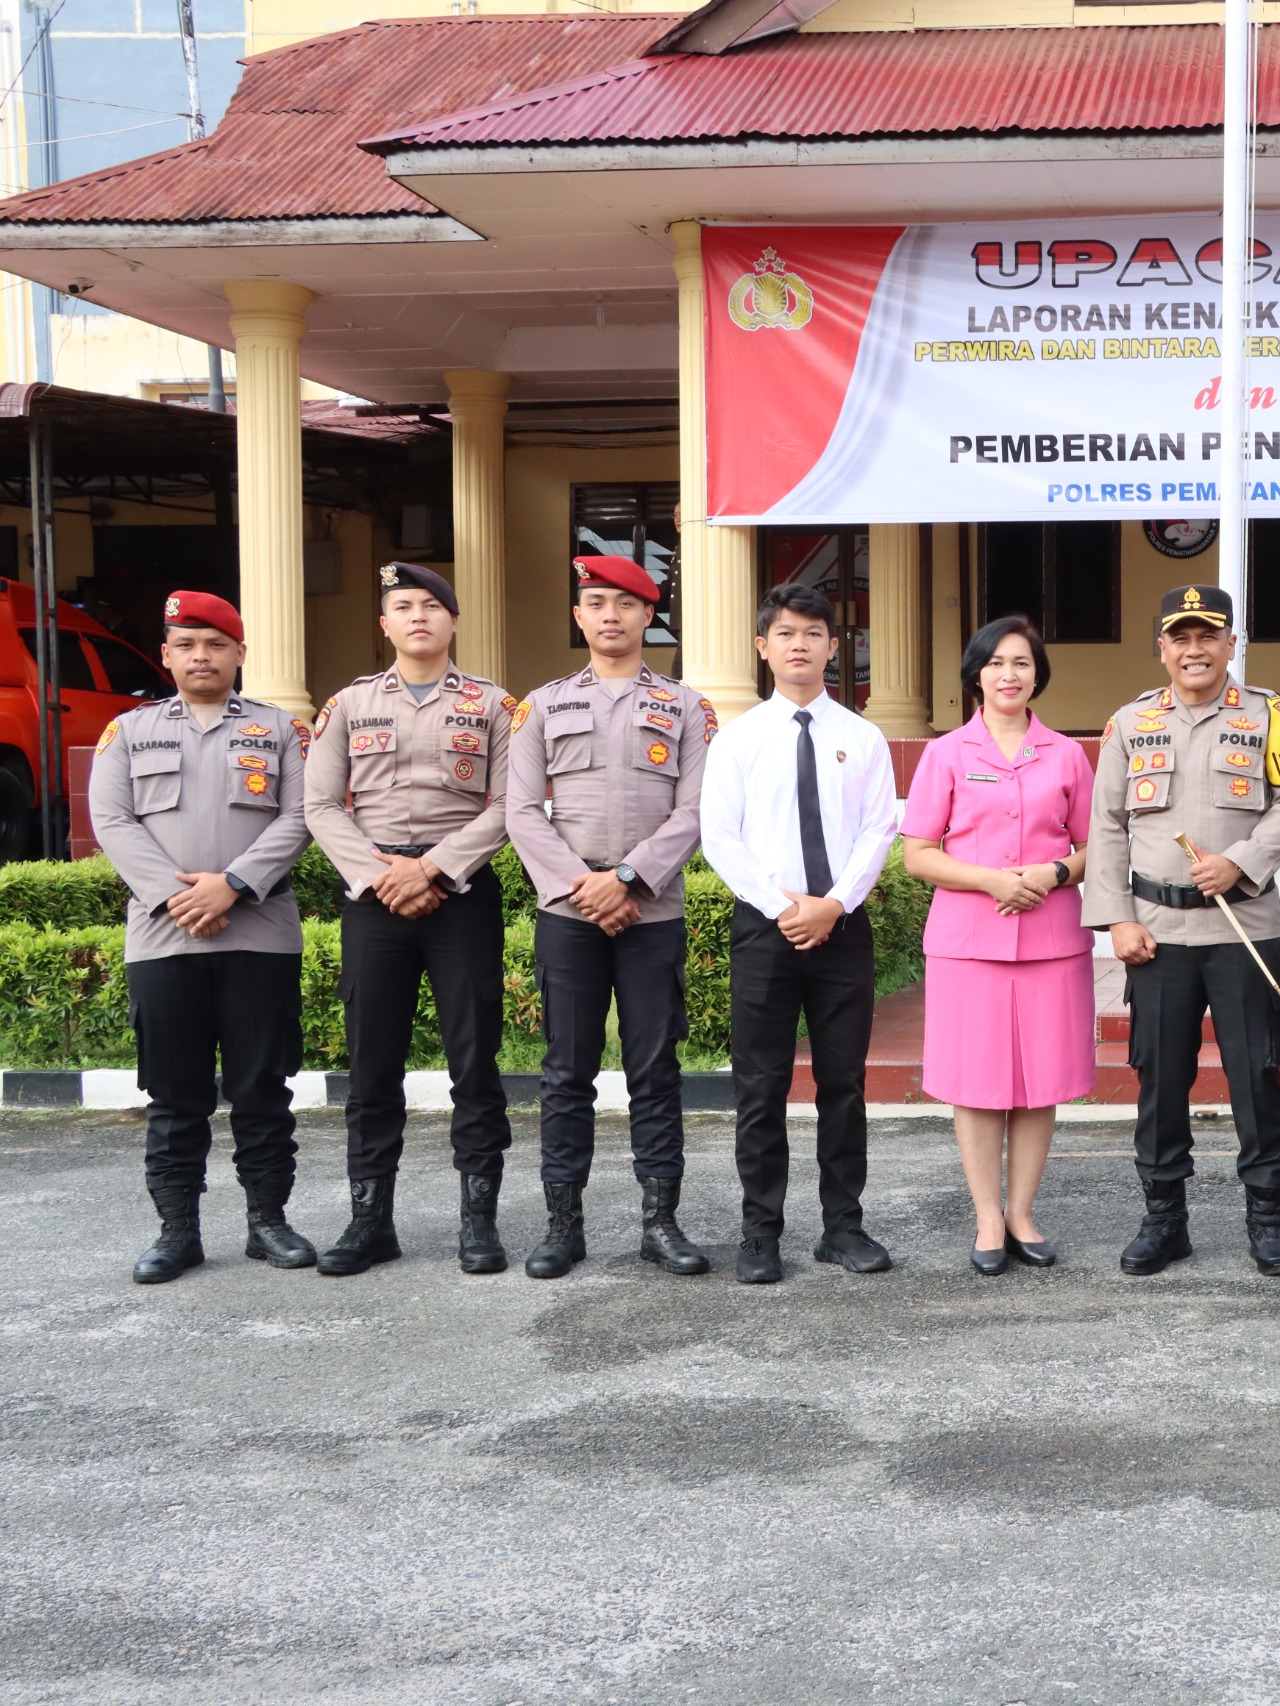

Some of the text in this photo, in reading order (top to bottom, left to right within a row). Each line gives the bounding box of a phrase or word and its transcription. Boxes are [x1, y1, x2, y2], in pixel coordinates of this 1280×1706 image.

[967, 303, 1131, 333] LAPORAN
[914, 339, 1034, 362] PERWIRA
[1040, 338, 1096, 361] DAN
[1103, 336, 1221, 360] BINTARA
[1193, 376, 1277, 410] dn
[949, 433, 1185, 463] PEMBERIAN
[1047, 483, 1152, 502] POLRES
[639, 701, 682, 717] POLRI
[444, 715, 489, 730] POLRI
[229, 739, 278, 751] POLRI
[1129, 733, 1263, 749] YOGEN POLRI
